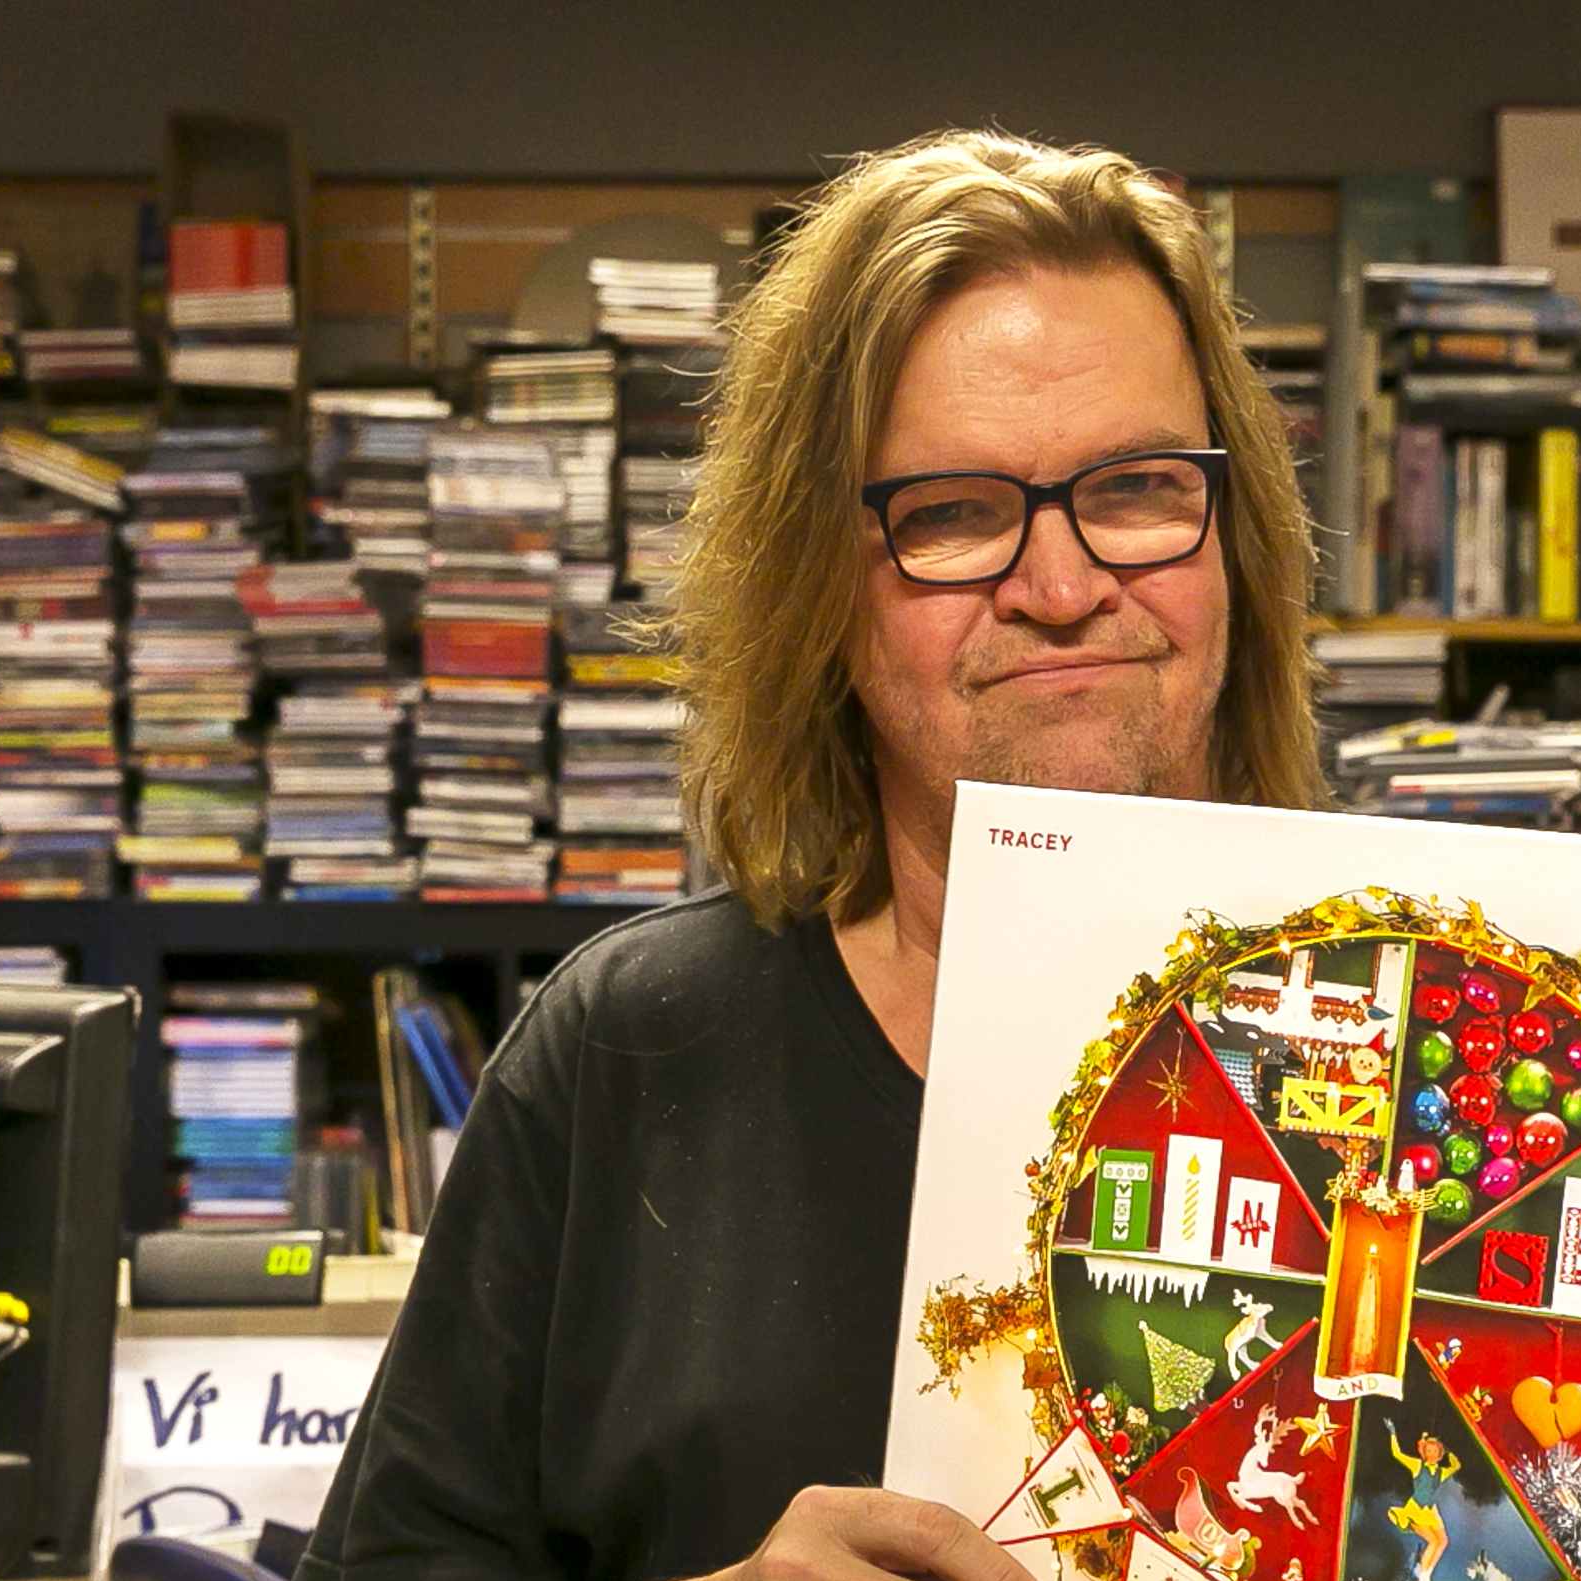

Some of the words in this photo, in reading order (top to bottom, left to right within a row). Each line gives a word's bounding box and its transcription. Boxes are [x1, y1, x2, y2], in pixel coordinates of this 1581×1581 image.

[987, 827, 1074, 853] TRACEY
[1336, 1375, 1380, 1399] AND
[142, 1370, 220, 1451] Vi
[259, 1371, 359, 1449] har
